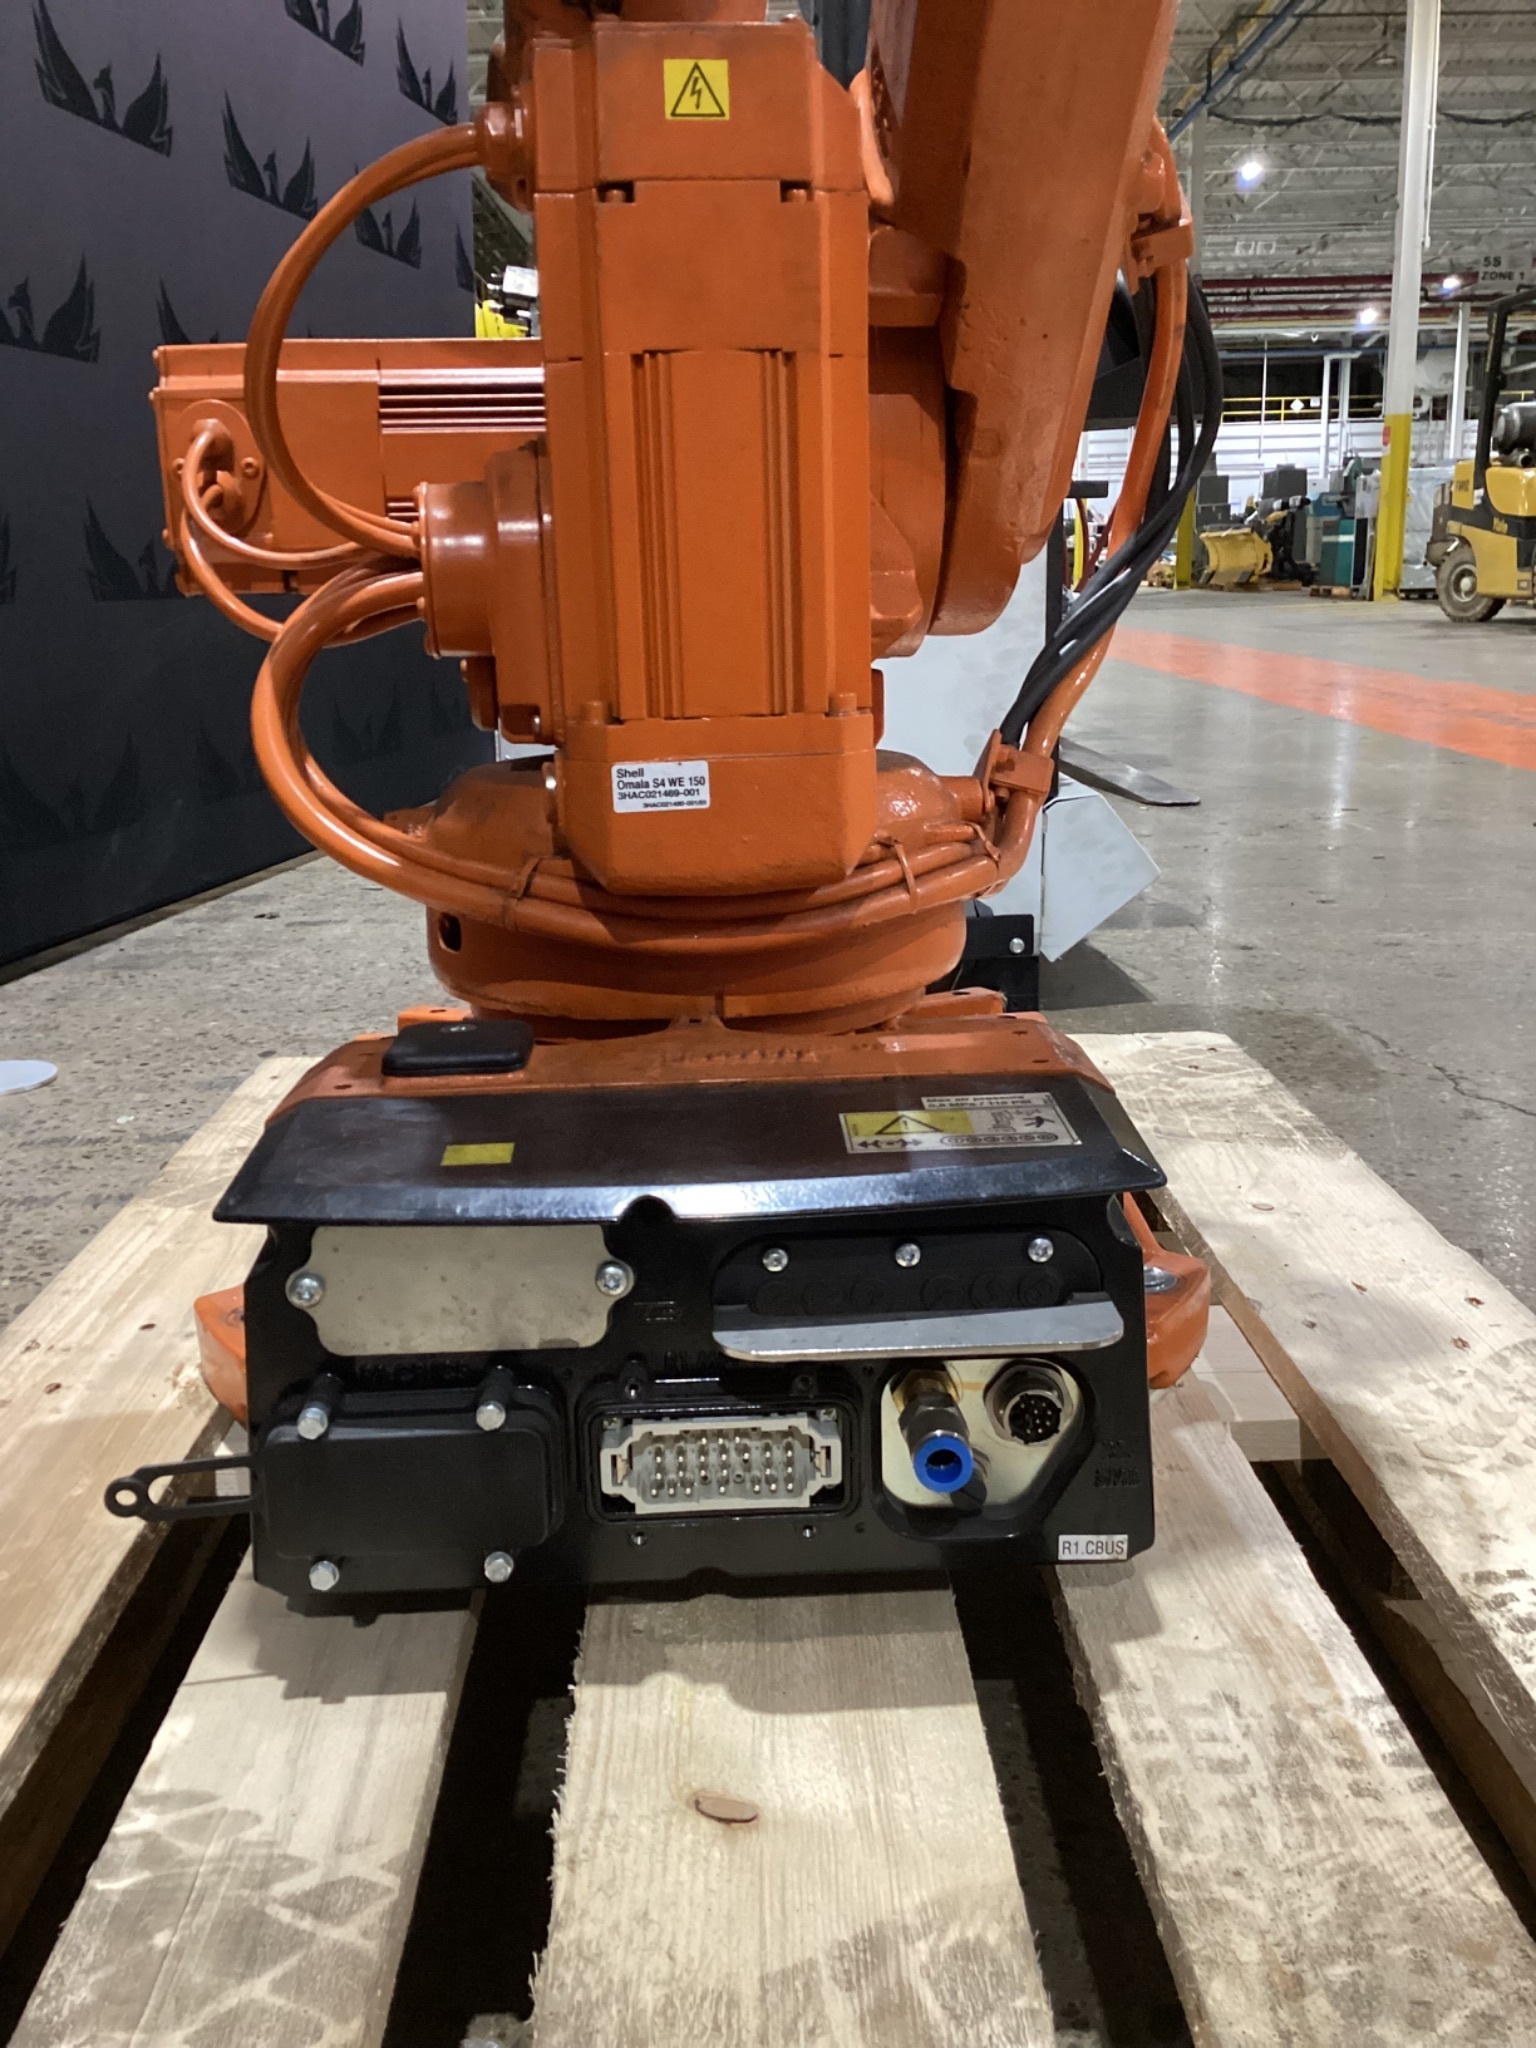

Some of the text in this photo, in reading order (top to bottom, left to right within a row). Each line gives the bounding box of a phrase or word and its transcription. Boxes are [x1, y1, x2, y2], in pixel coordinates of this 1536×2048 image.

[1481, 271, 1525, 281] ZONE 1
[616, 768, 644, 778] Shell
[617, 776, 706, 789] Omala S4 WE 150
[1062, 1540, 1124, 1555] R1.CBUS
